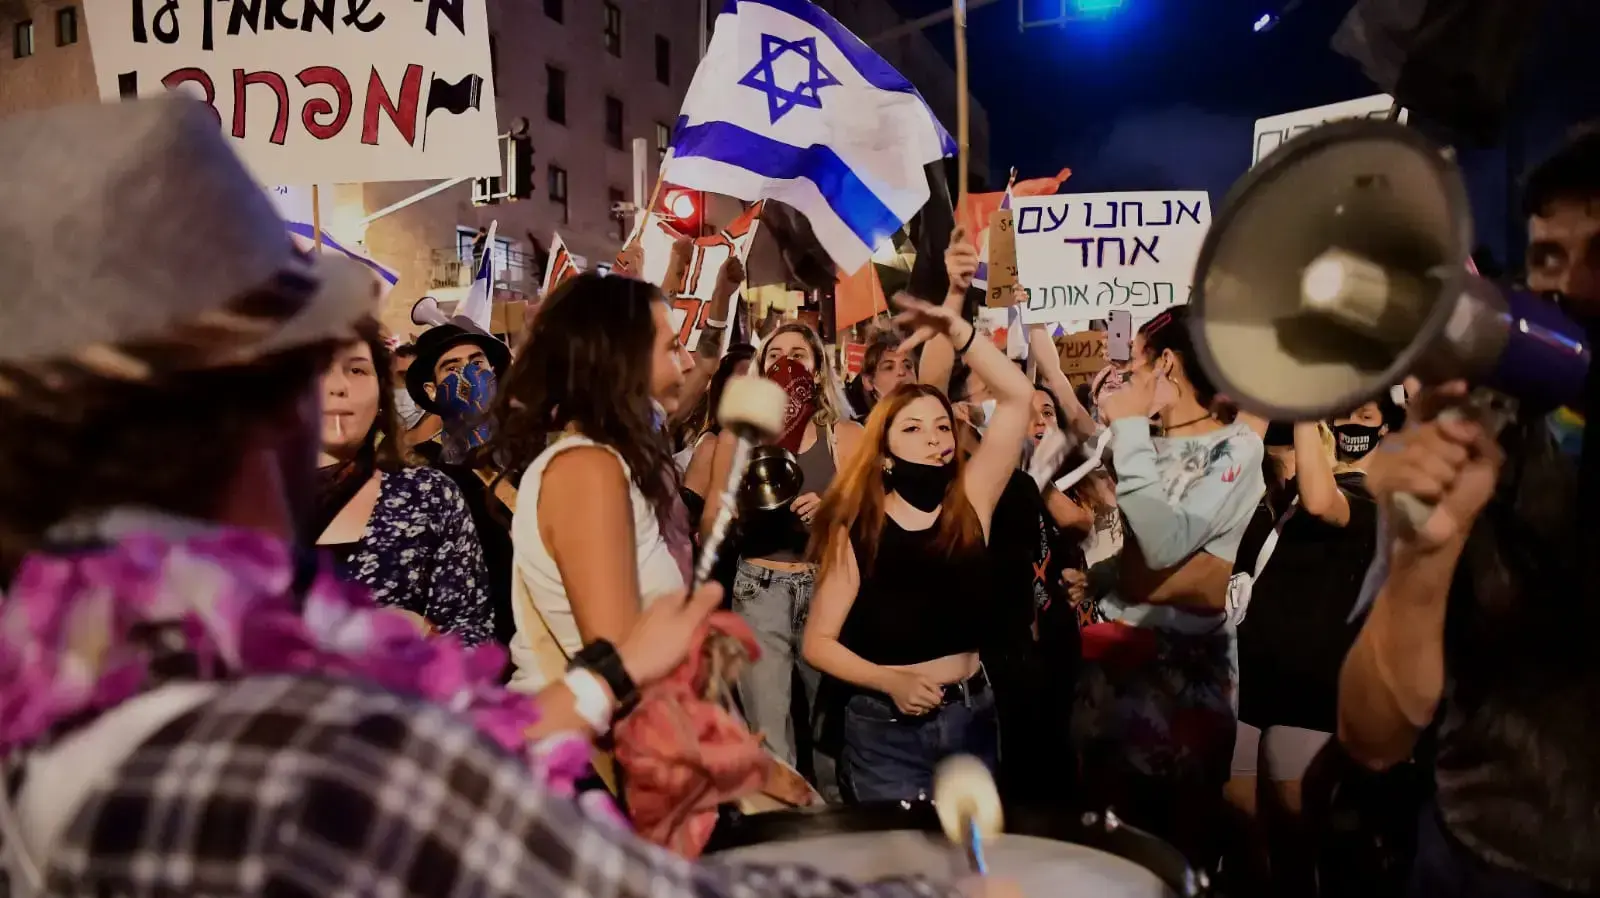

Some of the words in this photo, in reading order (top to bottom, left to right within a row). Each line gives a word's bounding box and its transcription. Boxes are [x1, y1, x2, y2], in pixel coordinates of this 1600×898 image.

[202, 0, 386, 51] שמאמן
[413, 0, 466, 37] מ
[1017, 203, 1069, 234] עם
[1083, 200, 1201, 229] אנחנו
[1063, 235, 1160, 269] אחד
[1025, 284, 1090, 312] אותנו
[1096, 277, 1174, 307] תפלג
